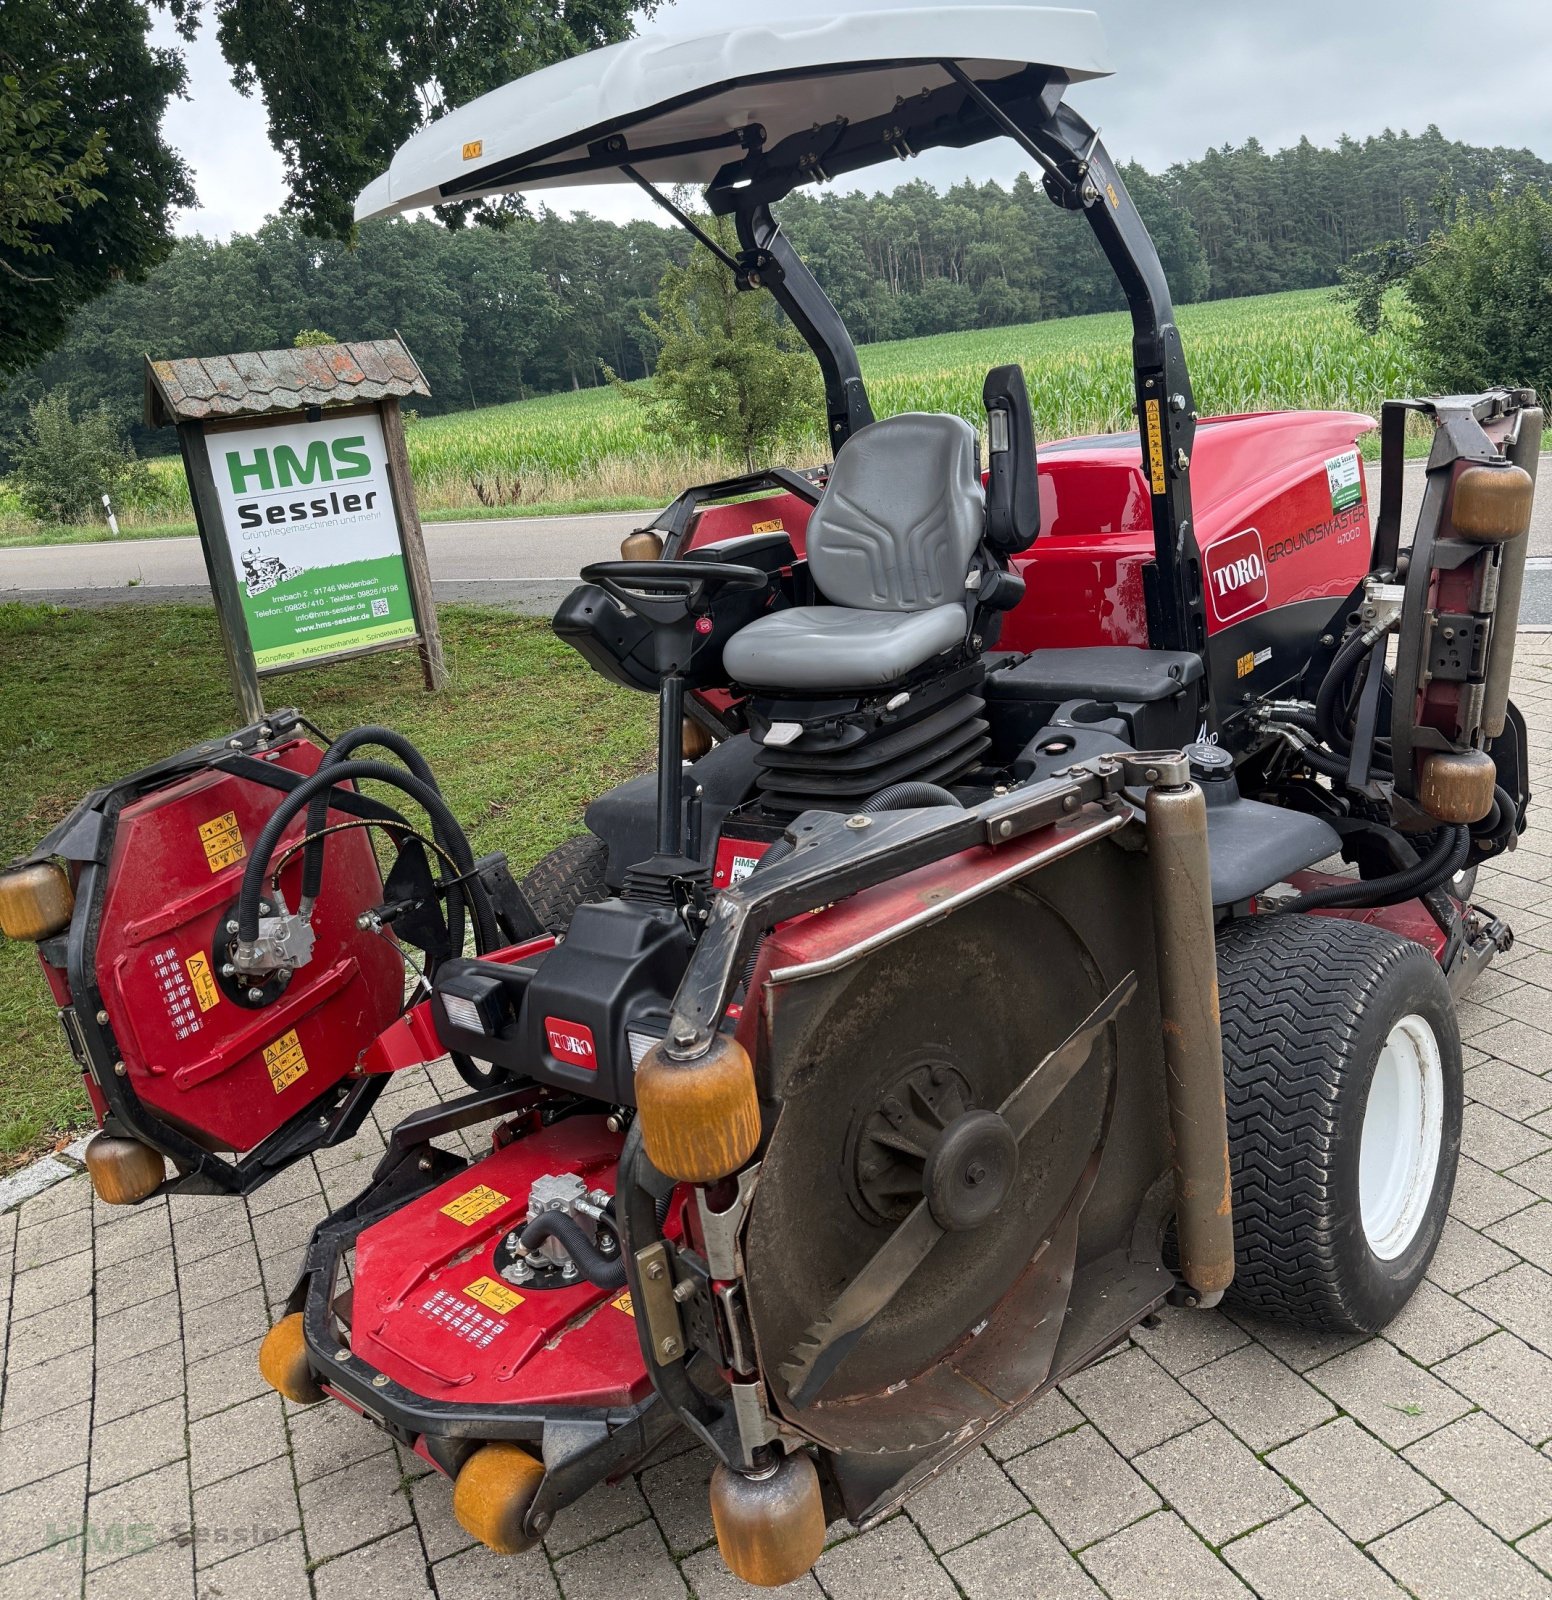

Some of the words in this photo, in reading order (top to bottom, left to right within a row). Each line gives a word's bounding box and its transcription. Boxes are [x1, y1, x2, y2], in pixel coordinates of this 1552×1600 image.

[225, 435, 372, 495] HMS
[237, 491, 377, 529] Sessler
[242, 517, 338, 541] Grünpflegemaschinen
[340, 514, 357, 525] und
[359, 511, 381, 523] mehr!
[1266, 505, 1366, 563] GROUNDSMASTER
[1337, 526, 1361, 545] 4700D
[1213, 553, 1260, 596] TORO
[303, 590, 308, 598] 2
[313, 584, 337, 595] 91746
[337, 577, 379, 590] Weidenbach
[254, 607, 283, 618] Telefon:
[330, 593, 356, 604] Telefax:
[295, 602, 366, 622] info@hms-sessler.de
[295, 612, 371, 634] www.hms-sessler.de
[257, 651, 295, 665] Grünpflege
[302, 636, 360, 655] Maschinenhandel
[366, 626, 414, 641] Spindelwartung
[735, 857, 756, 868] HMS
[549, 1031, 592, 1056] TORO
